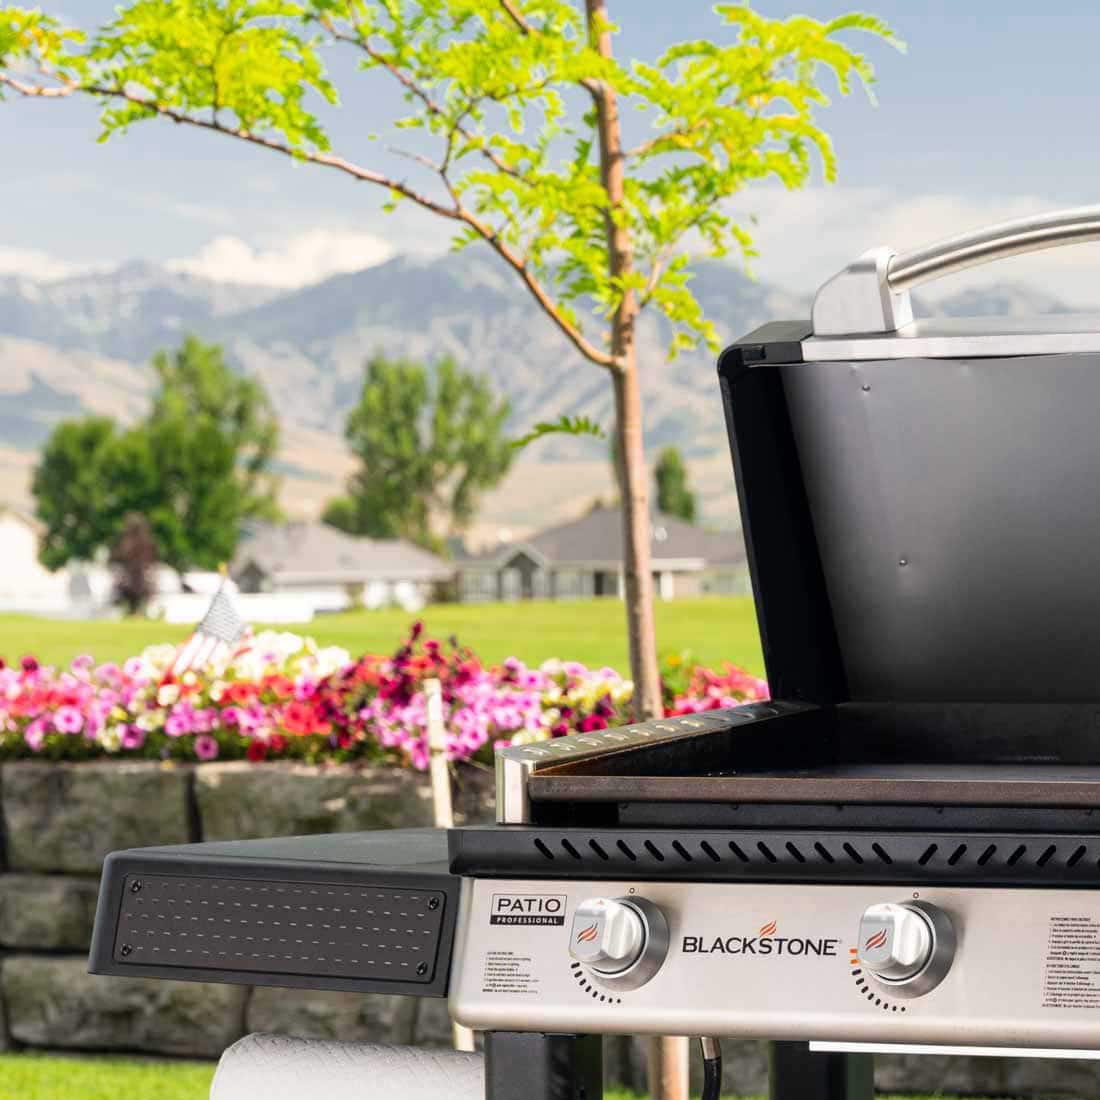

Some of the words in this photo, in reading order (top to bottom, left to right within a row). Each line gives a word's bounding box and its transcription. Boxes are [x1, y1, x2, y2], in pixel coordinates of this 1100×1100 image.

[497, 898, 561, 913] PATIO
[496, 916, 558, 925] PROFESSIONAL
[682, 936, 839, 956] BLACKSTONE
